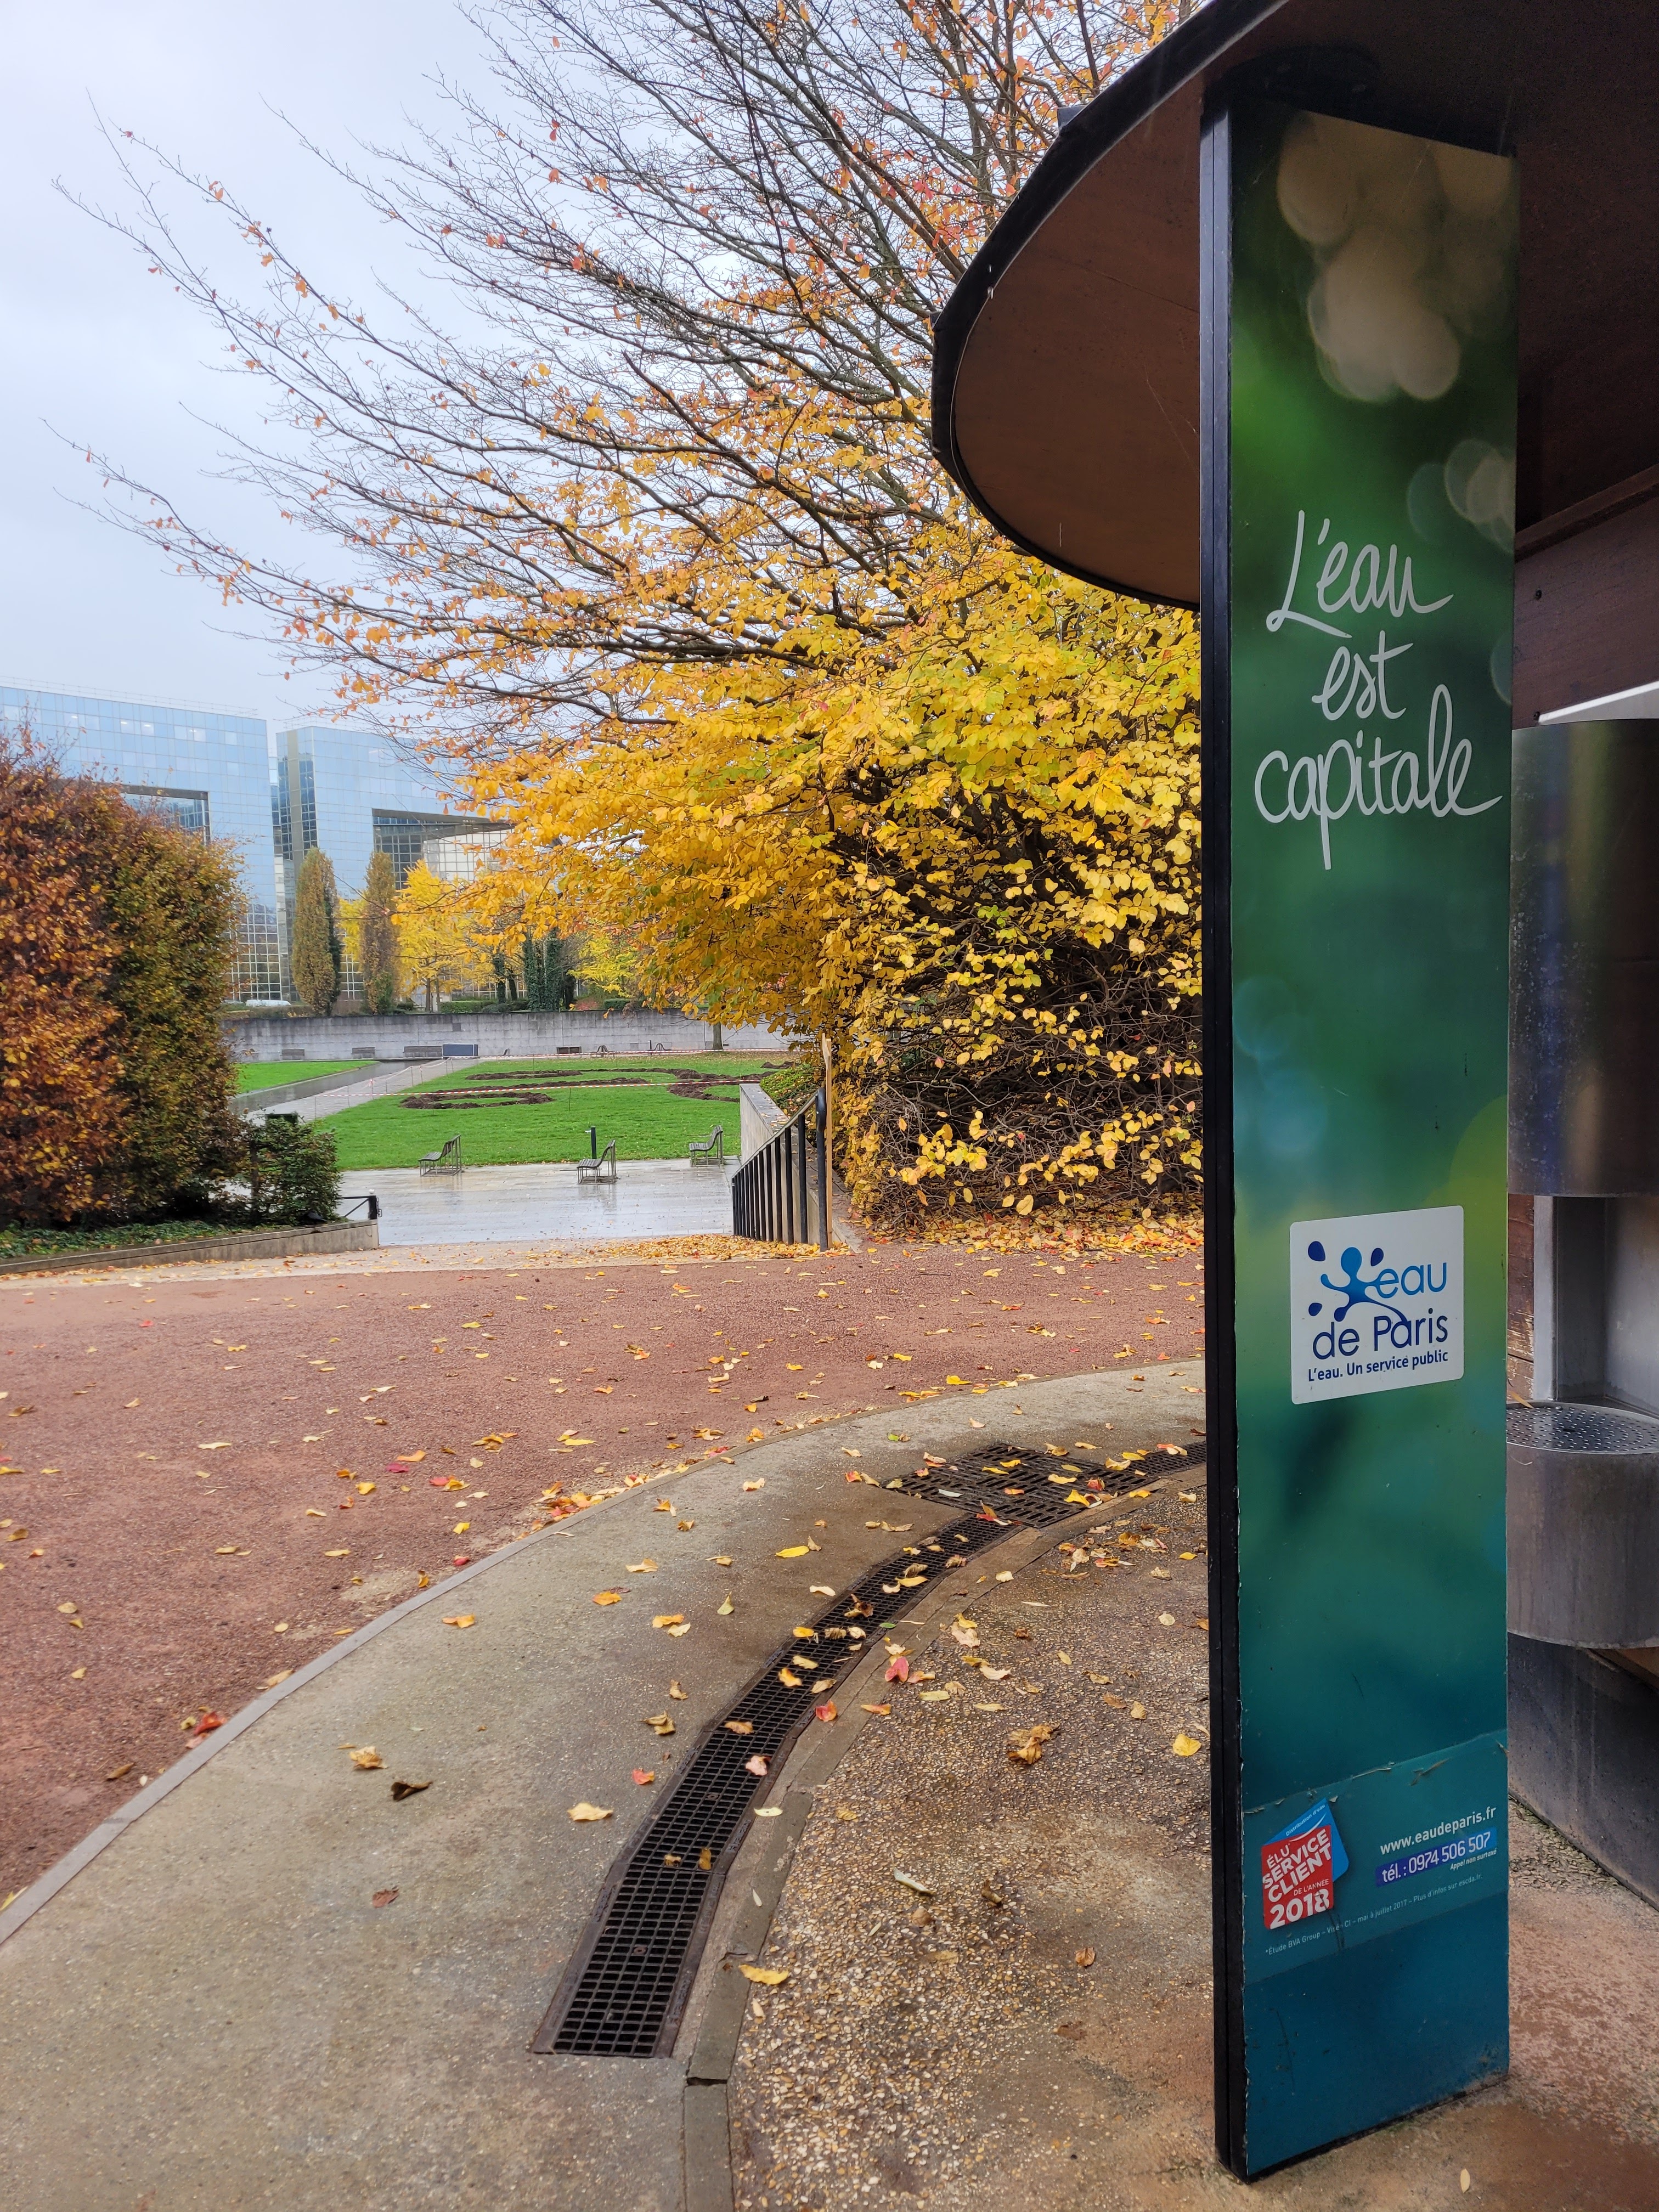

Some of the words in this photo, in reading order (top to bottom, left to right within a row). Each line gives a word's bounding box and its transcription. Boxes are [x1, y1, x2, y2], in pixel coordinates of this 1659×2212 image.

[1266, 510, 1453, 638] L'eau
[1312, 630, 1413, 721] est
[1254, 684, 1503, 870] capitale
[1375, 1262, 1447, 1299] eau
[1313, 1322, 1360, 1360] de
[1374, 1308, 1448, 1351] Paris
[1308, 1367, 1343, 1381] L'eau.
[1347, 1362, 1362, 1376] Un
[1366, 1356, 1408, 1373] service
[1412, 1349, 1448, 1370] public
[1285, 1813, 1312, 1837] Distribution
[1380, 1806, 1497, 1855] www.eaudeparis.fr
[1262, 1828, 1330, 1889] SERVICE
[1268, 1842, 1331, 1902] CLIENT
[1408, 1849, 1440, 1874] 0974
[1442, 1840, 1466, 1863] 506
[1469, 1831, 1491, 1853] 507
[1450, 1859, 1465, 1871] Appel
[1465, 1855, 1476, 1865] non
[1270, 1888, 1330, 1930] 2018
[1288, 1938, 1301, 1948] BVA
[1302, 1932, 1321, 1943] Group
[1358, 1914, 1369, 1923] mai
[1375, 1905, 1393, 1919] juillet
[1393, 1899, 1408, 1911] 2017
[1413, 1894, 1427, 1903] Plus
[1448, 1882, 1458, 1892] sur
[1294, 1887, 1302, 1896] DE
